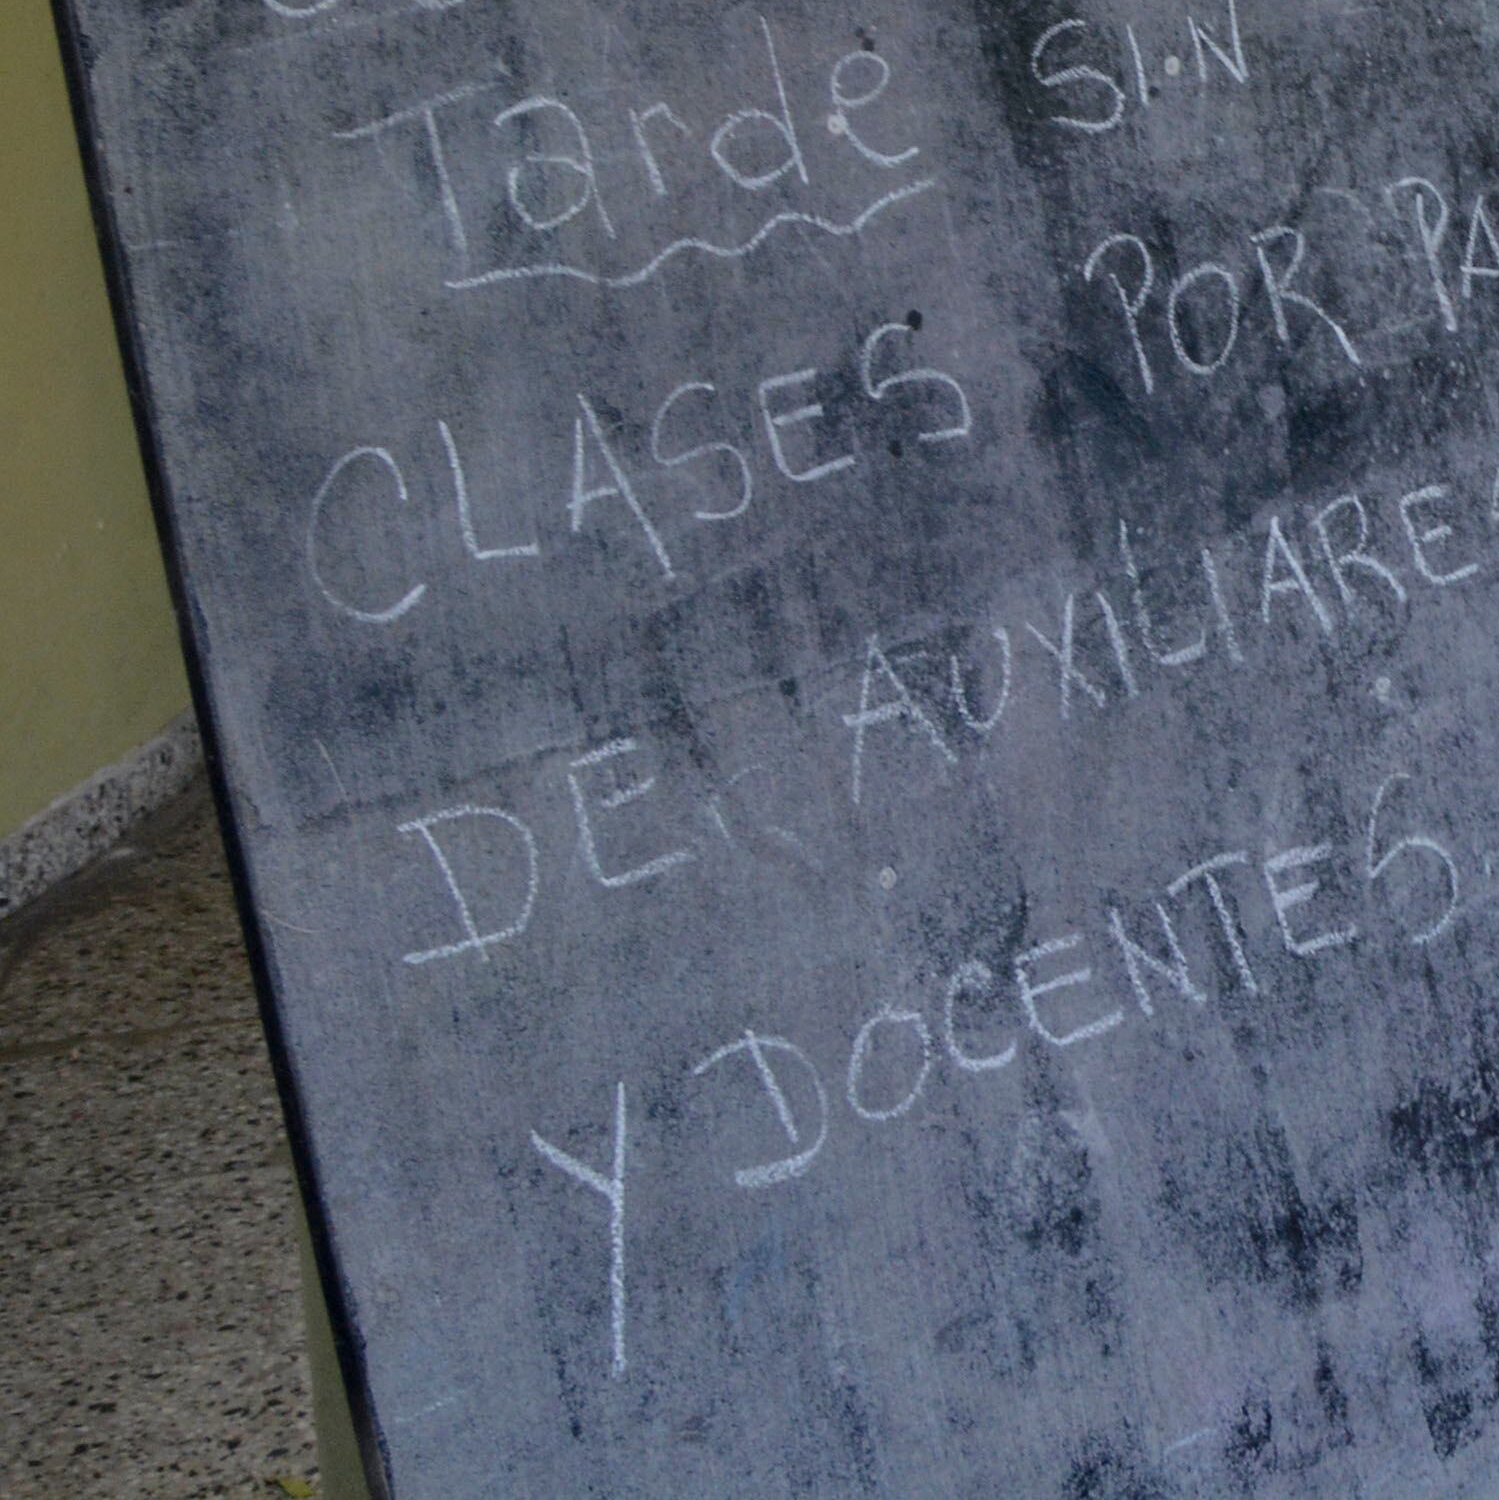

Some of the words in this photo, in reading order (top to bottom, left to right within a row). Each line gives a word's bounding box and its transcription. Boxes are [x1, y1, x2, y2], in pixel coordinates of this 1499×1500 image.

[337, 16, 922, 256] Tarde
[308, 322, 972, 621] CLASES
[1084, 226, 1363, 396] POR
[398, 737, 697, 967] DE
[530, 1080, 629, 1380] Y
[693, 772, 1464, 1190] DOCENTES
